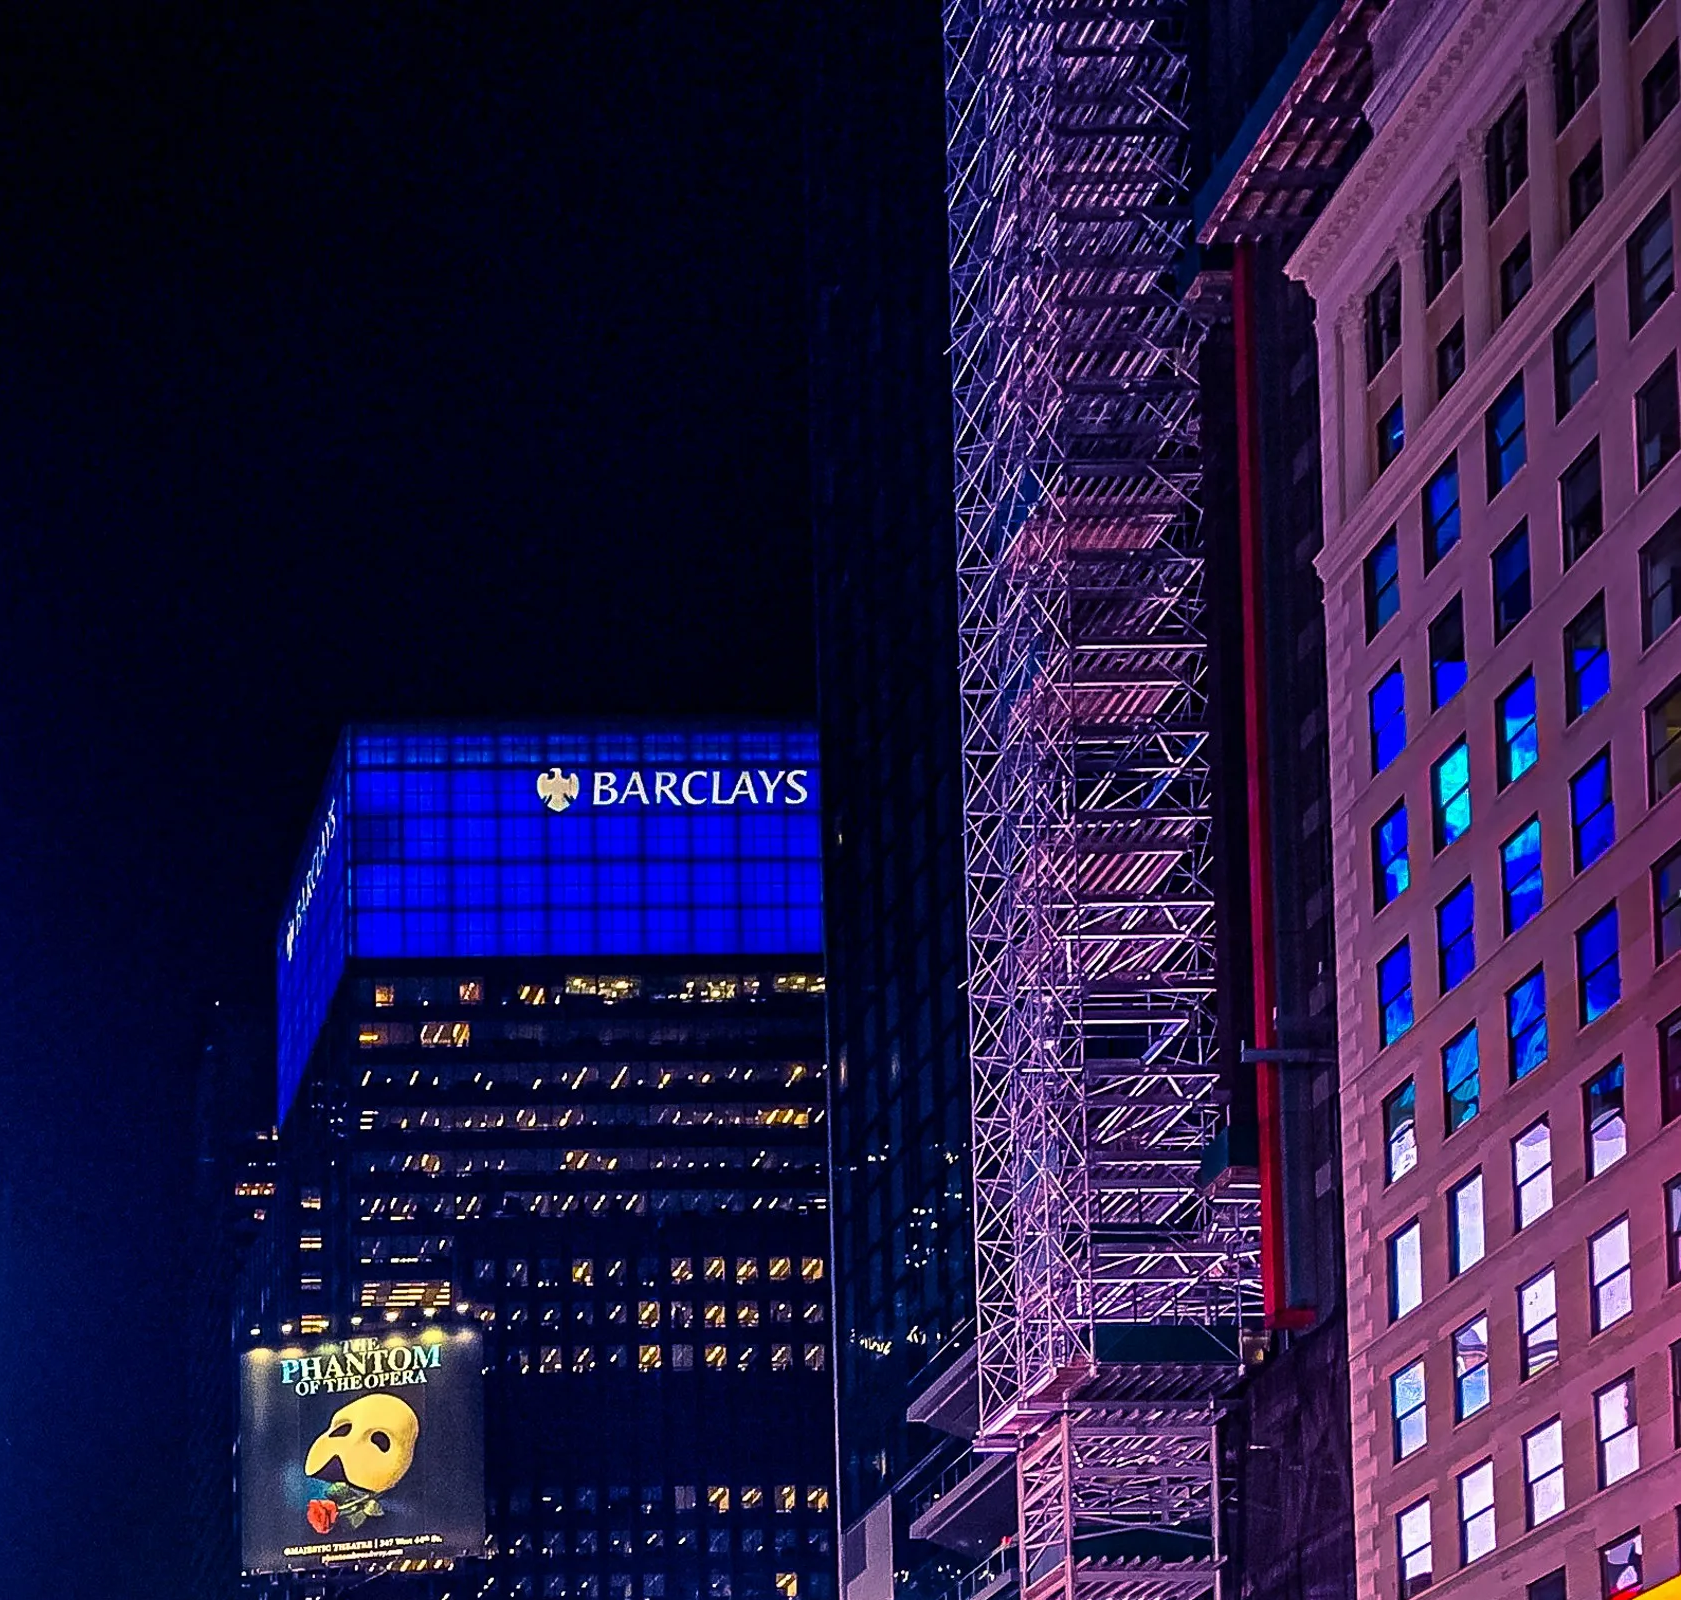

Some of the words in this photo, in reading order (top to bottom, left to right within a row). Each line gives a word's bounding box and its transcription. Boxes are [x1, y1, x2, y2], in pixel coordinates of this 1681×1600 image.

[592, 769, 809, 806] BARCLAYS
[340, 1337, 380, 1354] THE
[280, 1344, 442, 1384] PHANTOM
[295, 1378, 322, 1396] OF
[322, 1377, 364, 1394] THE
[364, 1369, 428, 1389] OPERA
